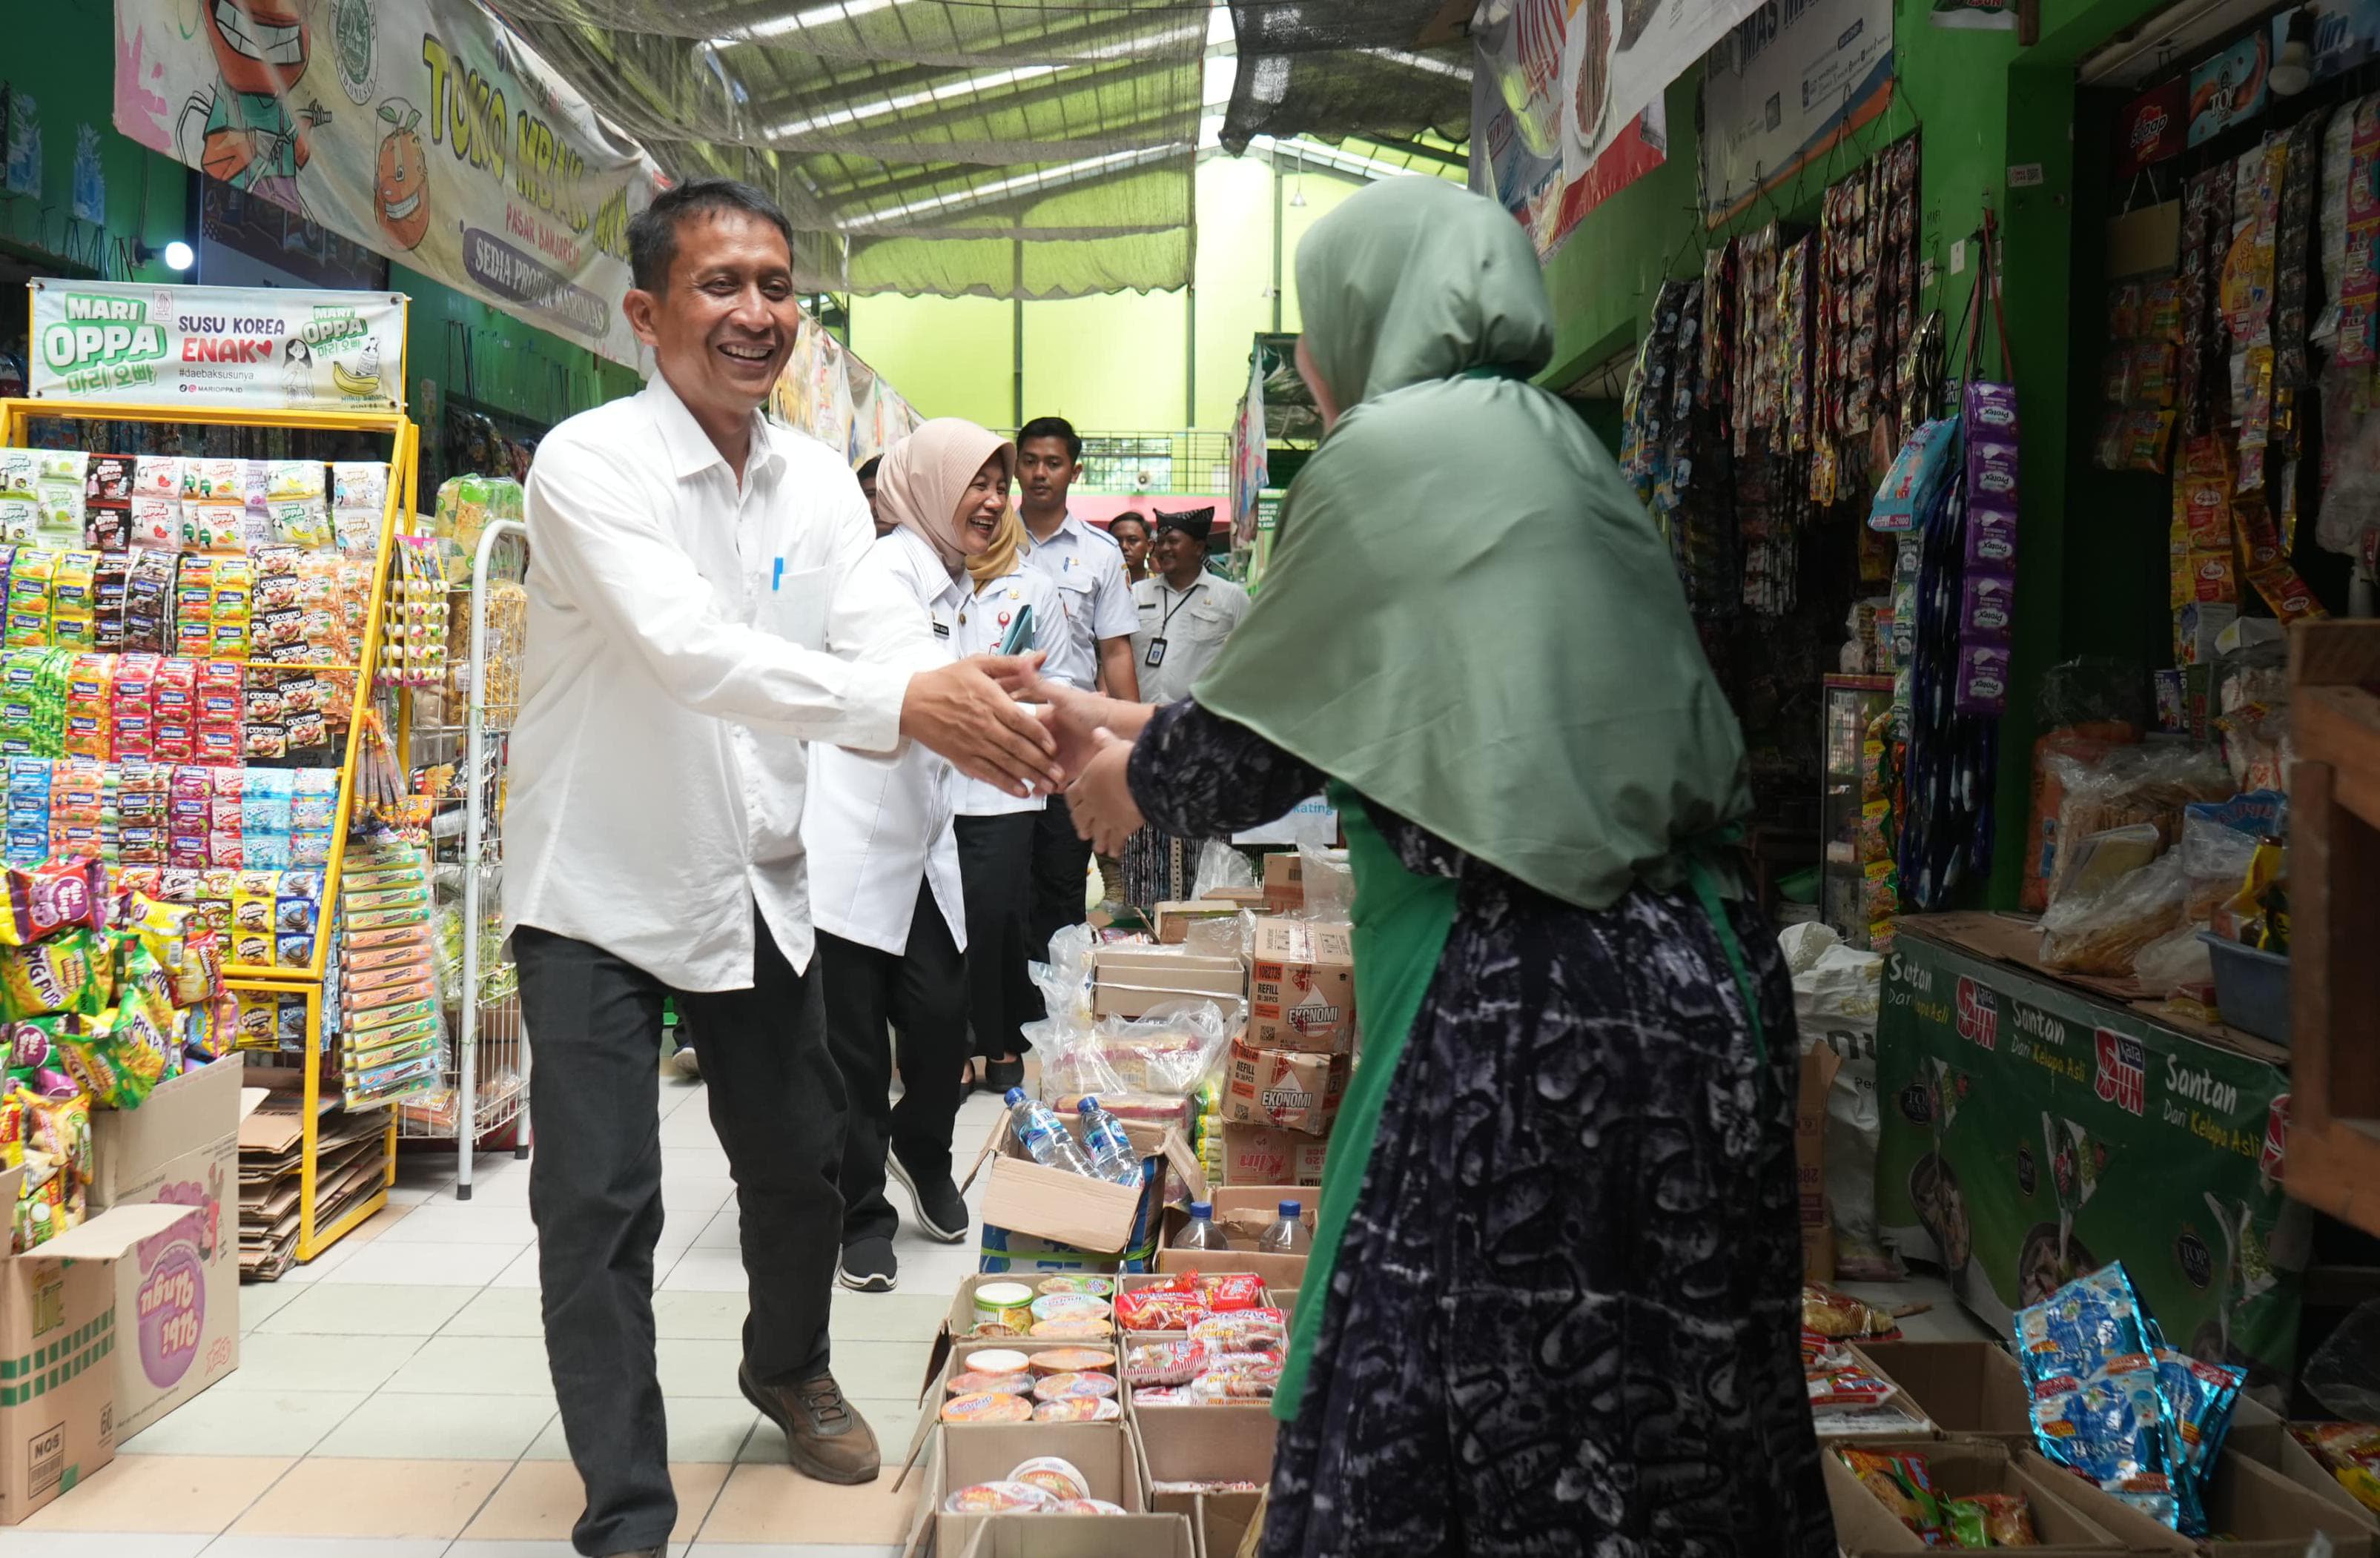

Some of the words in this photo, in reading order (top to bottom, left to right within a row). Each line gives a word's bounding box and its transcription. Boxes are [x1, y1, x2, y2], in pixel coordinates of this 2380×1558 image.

[423, 32, 507, 185] TOKO
[517, 110, 589, 235] MBAK
[506, 202, 535, 245] PASAR
[475, 236, 511, 287] SEDIA
[512, 258, 556, 309] PRODUK
[68, 298, 139, 321] MARI
[178, 315, 225, 334] SUSU
[233, 317, 285, 336] KOREA
[302, 318, 365, 344] OPPA
[45, 324, 161, 368] OPPA
[182, 337, 257, 364] ENAK
[66, 368, 111, 395] 마리
[113, 363, 156, 391] 오빠
[179, 367, 254, 382] #daebaksusunya
[1984, 408, 2009, 419] Protex
[96, 465, 123, 474] OPPA
[212, 465, 237, 475] OPPA
[1985, 473, 2009, 484] Protex
[95, 514, 119, 525] OPPA
[142, 508, 169, 518] OPPA
[210, 514, 236, 524] OPPA
[279, 508, 305, 521] OPPA
[345, 522, 370, 531] OPPA
[1983, 542, 2007, 553] Protex
[261, 578, 297, 589] COCORIO
[185, 592, 208, 602] Marimas
[218, 593, 243, 603] Marimas
[265, 610, 301, 623] COCORIO
[1978, 611, 2003, 622] Protex
[184, 628, 208, 637] Marimas
[217, 629, 242, 638] Marimas
[272, 646, 307, 657] COCORIO
[279, 680, 314, 692] COCORIO
[1974, 680, 1999, 691] Protex
[286, 713, 321, 727] COCORIO
[248, 726, 283, 736] COCORIO
[162, 869, 199, 878] COCORIO
[68, 879, 84, 905] Ubi
[56, 886, 71, 921] Ungu
[237, 903, 269, 920] COCORIO
[237, 940, 269, 956] COCORIO
[1257, 982, 1279, 995] REFILL
[1288, 1005, 1339, 1025] EKONOMI
[1956, 974, 1997, 1051] SUN
[2012, 1000, 2065, 1046] Santan
[2011, 1033, 2030, 1058] Dari
[2031, 1043, 2065, 1075] Kelapa
[2066, 1058, 2087, 1083] Asli
[1236, 1061, 1255, 1075] REFILL
[2094, 1027, 2145, 1118] SUN
[2165, 1053, 2237, 1115] Santan
[1261, 1090, 1312, 1108] EKONOMI
[2164, 1098, 2186, 1128] Dari
[2190, 1111, 2229, 1148] Kelapa
[2232, 1129, 2261, 1159] Asli
[1239, 1153, 1284, 1179] Klin
[2181, 1245, 2207, 1265] TOP
[139, 1268, 195, 1317] Ungu
[159, 1308, 199, 1353] Ubi
